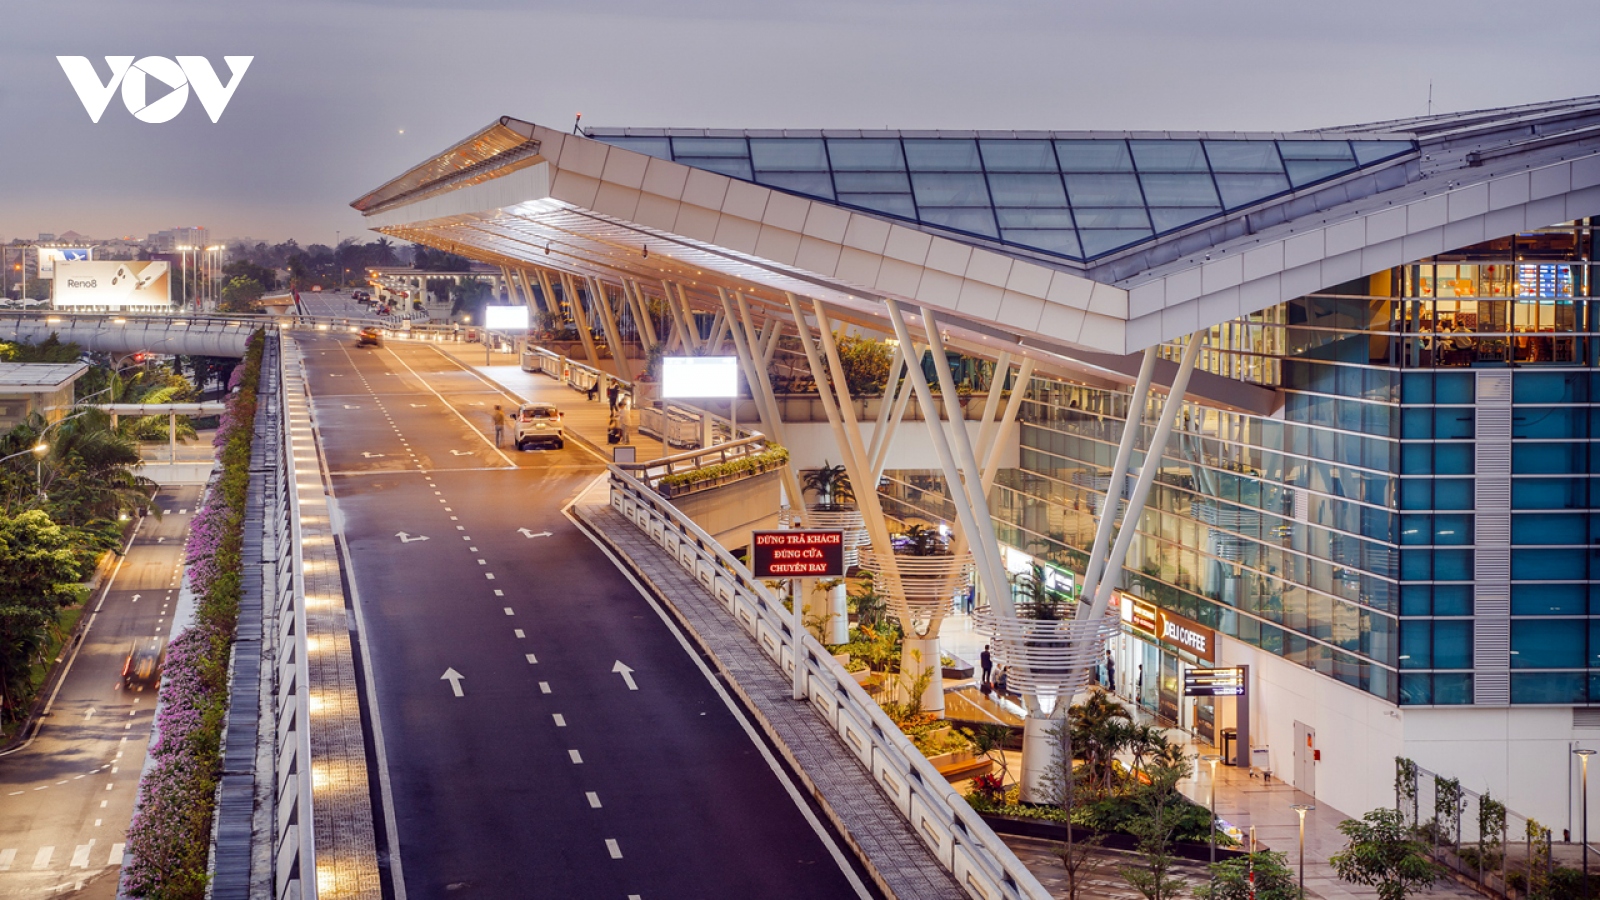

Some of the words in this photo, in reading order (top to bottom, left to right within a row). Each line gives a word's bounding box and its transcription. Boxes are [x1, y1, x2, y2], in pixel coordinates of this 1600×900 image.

[68, 279, 97, 288] Reno8
[806, 534, 840, 543] KHÁCH
[809, 563, 827, 572] BAY
[1165, 621, 1179, 640] DELI
[1180, 627, 1206, 652] COFFEE
